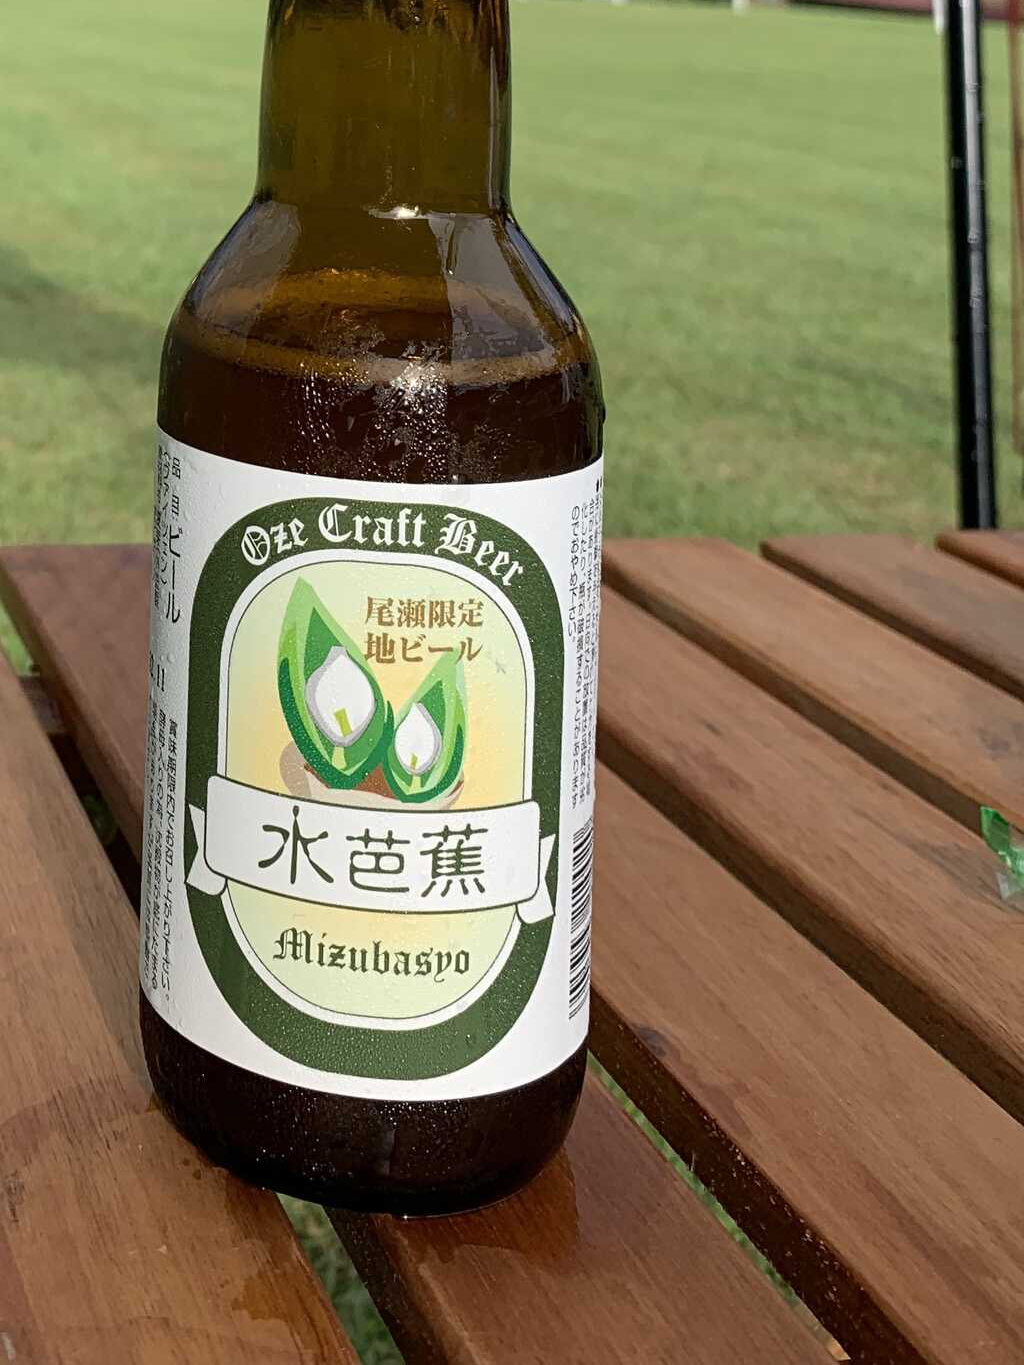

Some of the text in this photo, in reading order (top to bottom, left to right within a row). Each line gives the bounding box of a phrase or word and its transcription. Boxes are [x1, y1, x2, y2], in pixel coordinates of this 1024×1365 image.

[240, 502, 524, 586] Oze Craft Beer
[364, 595, 485, 629] 尾瀬限定
[364, 632, 484, 665] 地ビール
[257, 804, 489, 898] 水芭蕉
[272, 926, 471, 984] Mizubasyo
